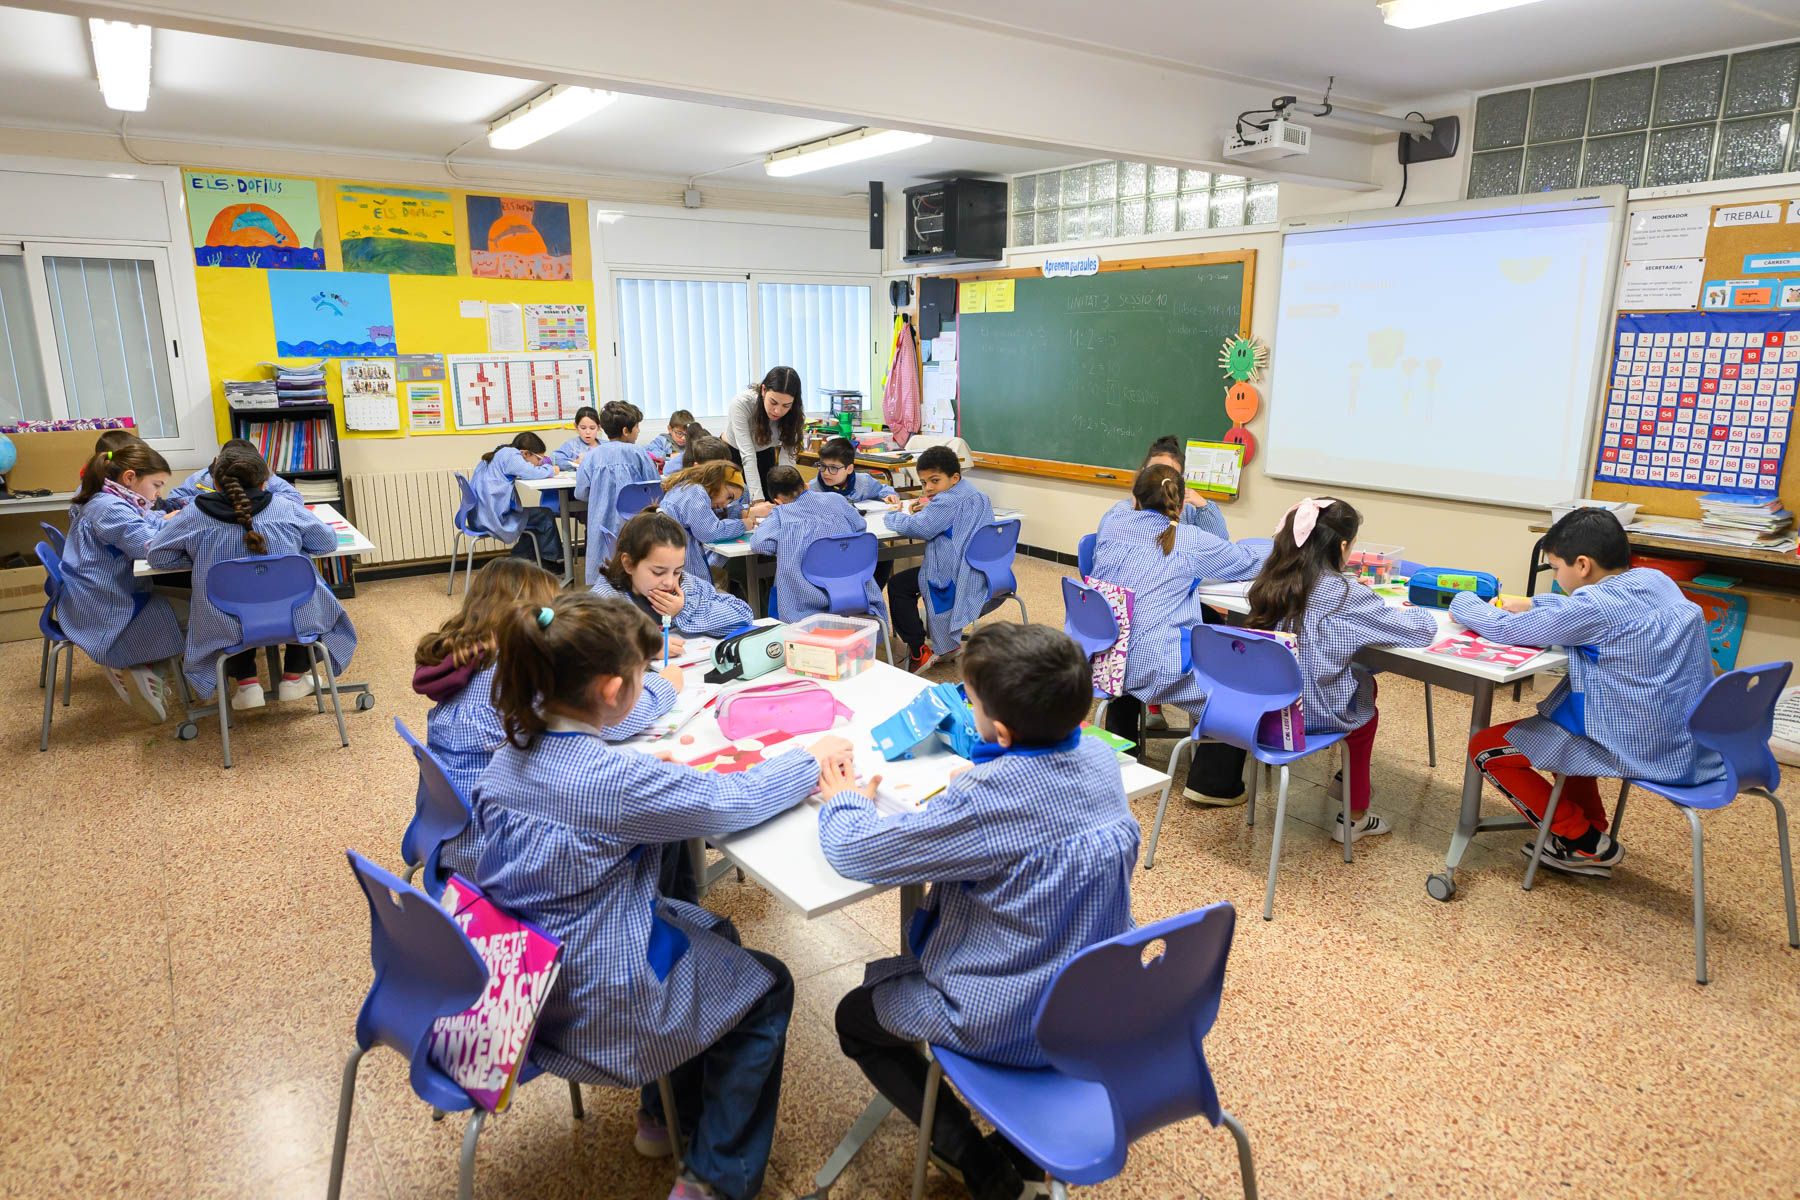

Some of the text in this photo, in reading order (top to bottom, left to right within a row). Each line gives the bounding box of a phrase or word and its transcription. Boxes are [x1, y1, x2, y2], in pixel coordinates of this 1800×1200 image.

[1724, 210, 1773, 222] TREBALL
[1044, 258, 1097, 274] Aprenem paraules
